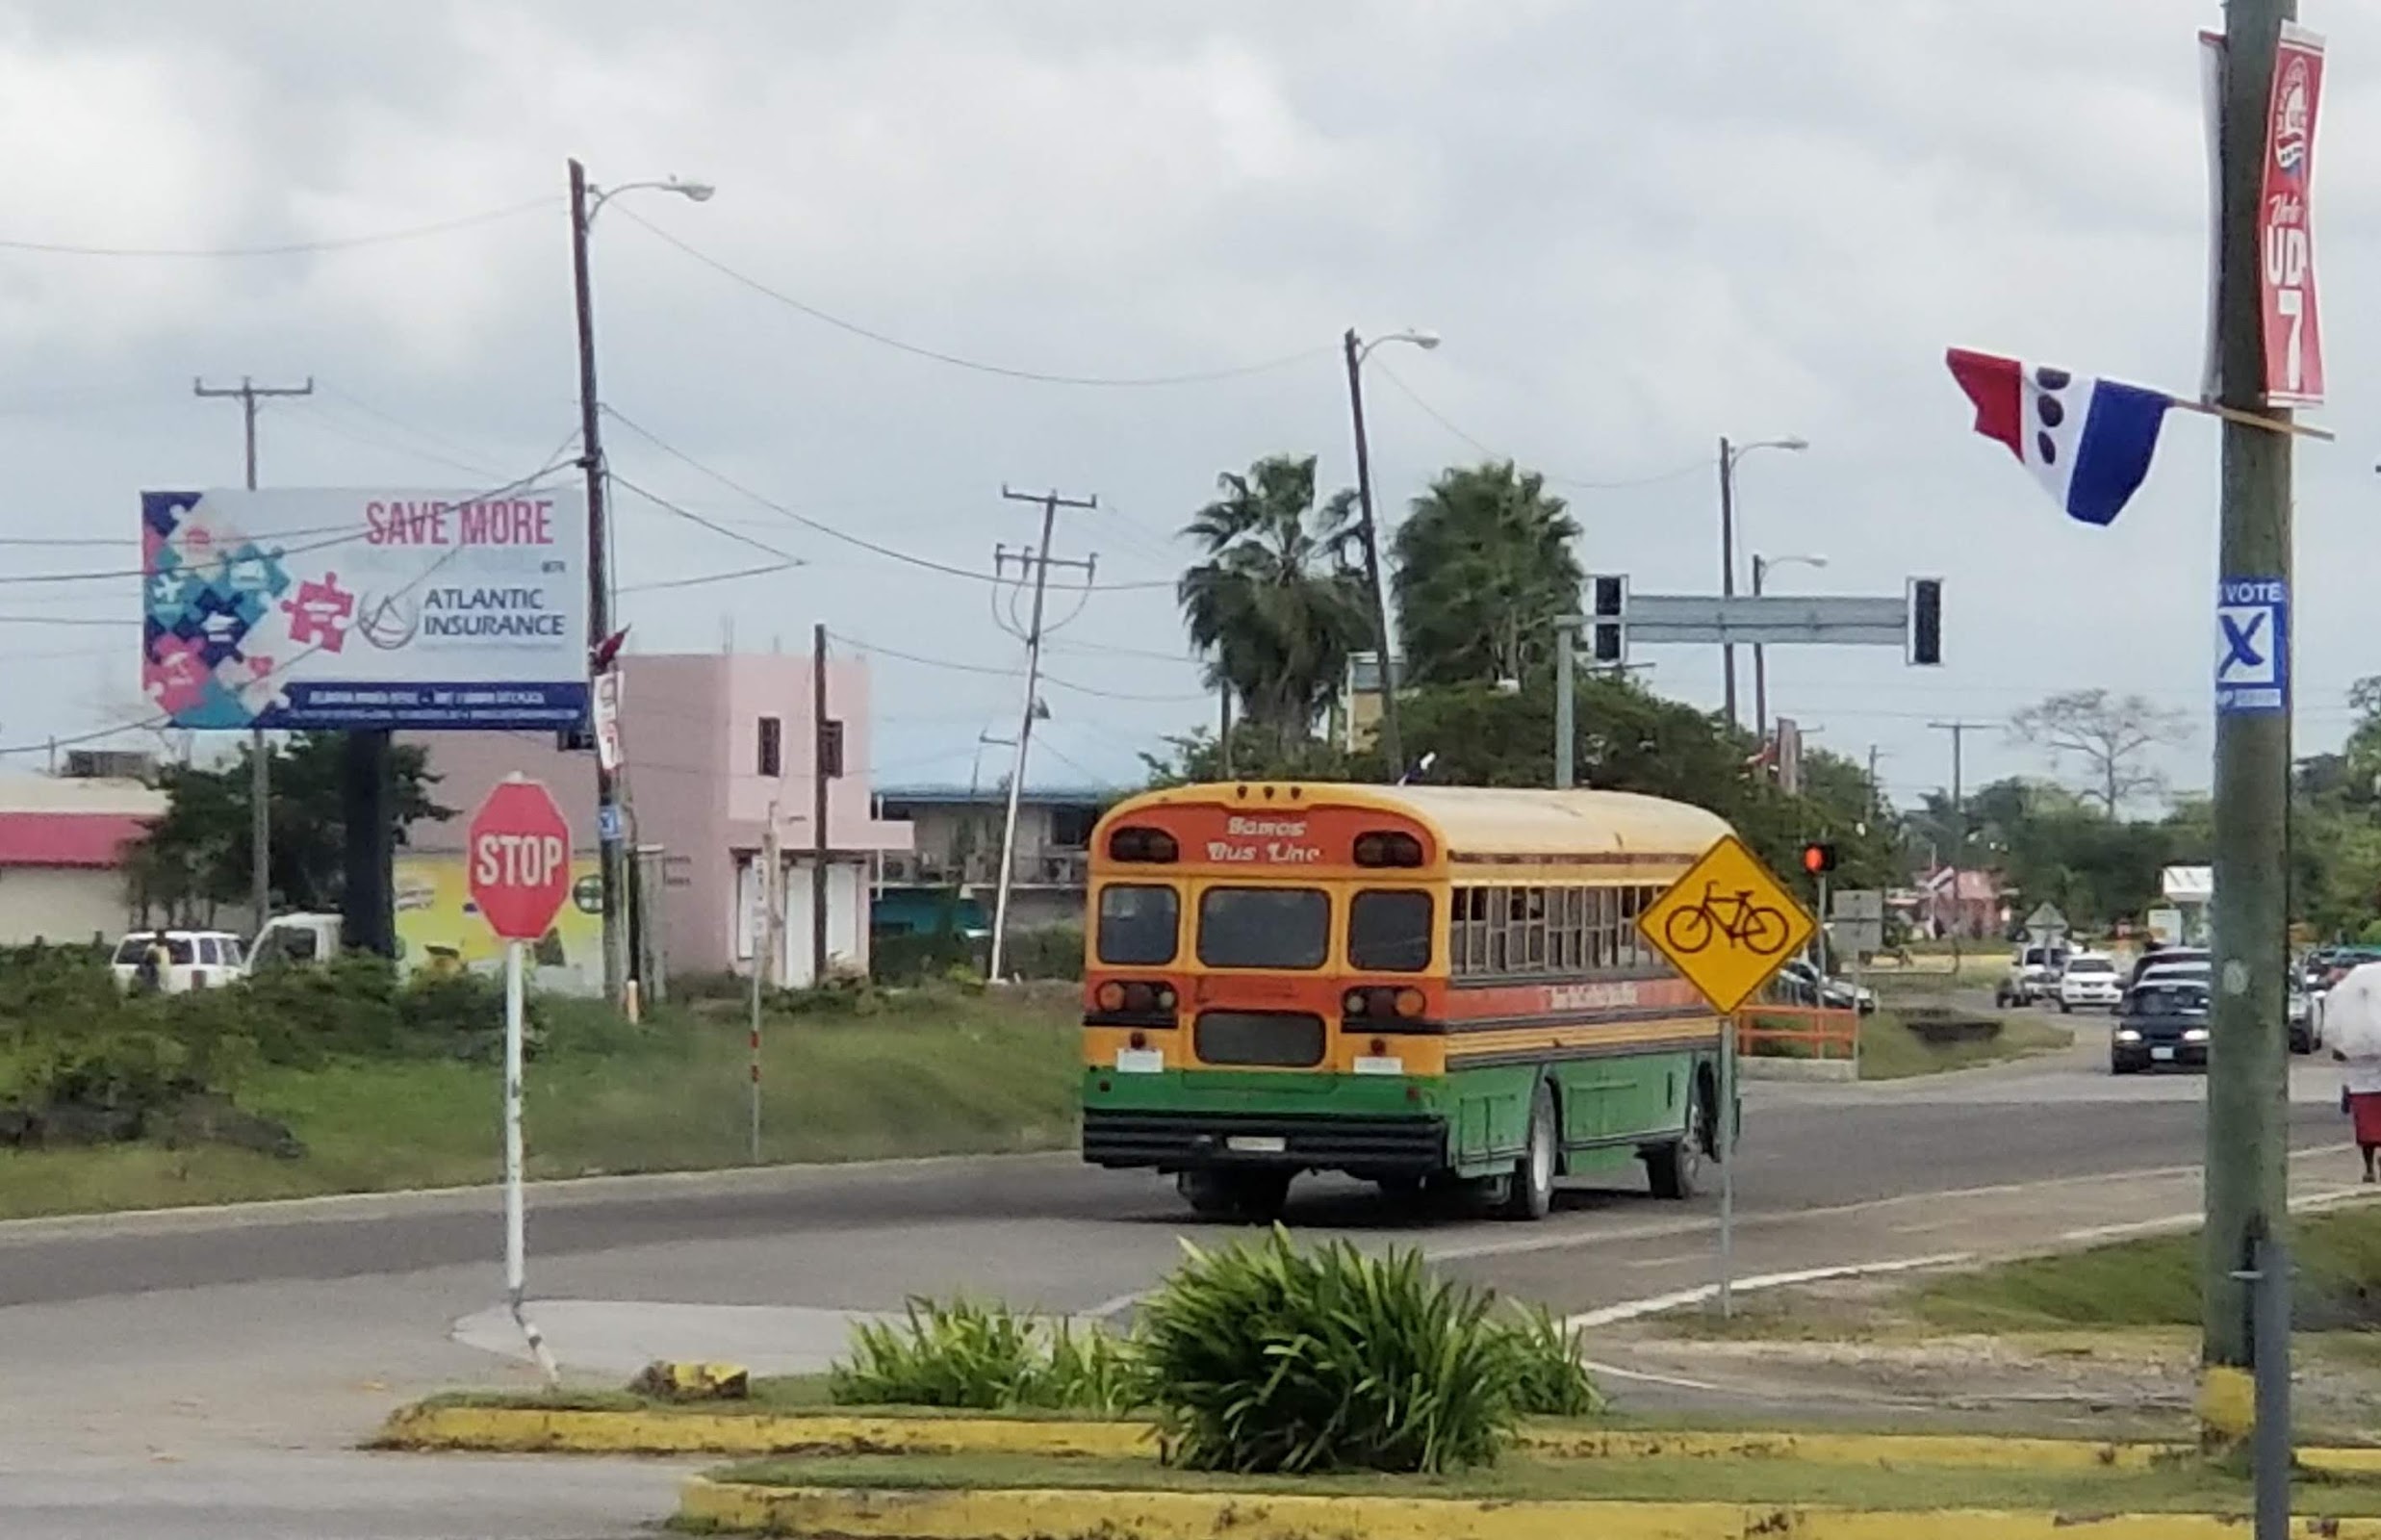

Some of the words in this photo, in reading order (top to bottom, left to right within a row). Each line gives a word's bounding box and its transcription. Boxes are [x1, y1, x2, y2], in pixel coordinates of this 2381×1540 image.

[2278, 289, 2303, 390] 7
[366, 500, 449, 545] SAVE
[460, 500, 554, 545] MORE
[423, 588, 544, 609] ATLANTIC
[2224, 581, 2284, 603] VOTE
[423, 614, 566, 635] INSURANCE
[475, 833, 563, 886] STOP
[1206, 841, 1258, 861] Bus
